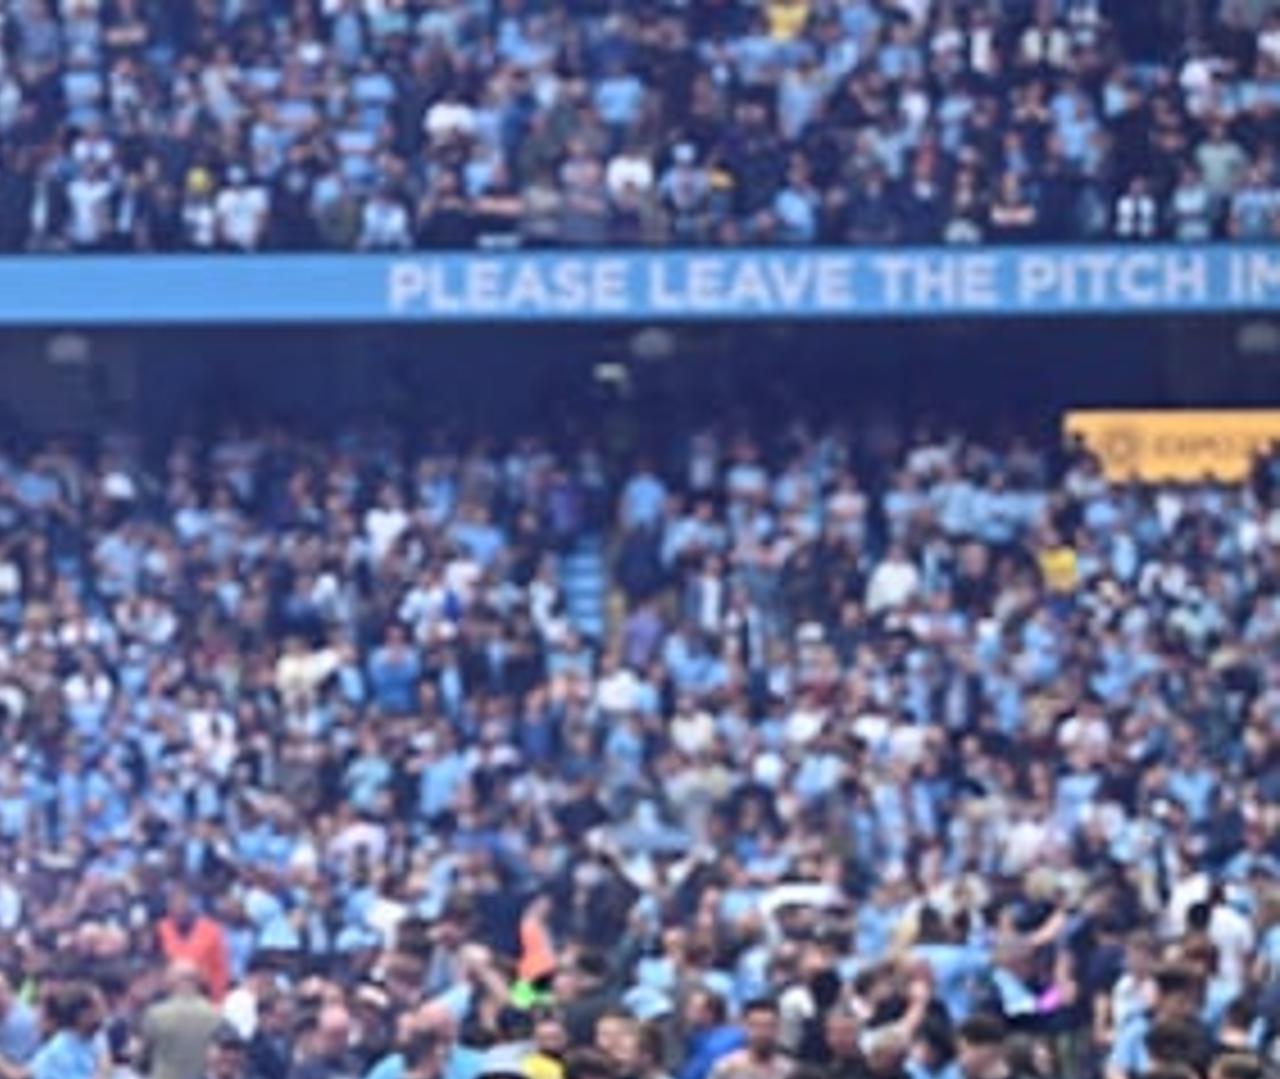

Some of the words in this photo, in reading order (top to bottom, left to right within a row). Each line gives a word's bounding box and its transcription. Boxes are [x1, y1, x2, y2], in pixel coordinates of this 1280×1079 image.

[390, 259, 630, 312] PLEASE
[649, 257, 852, 310] LEAVE
[876, 254, 997, 306] THE
[1019, 252, 1207, 303] PITCH
